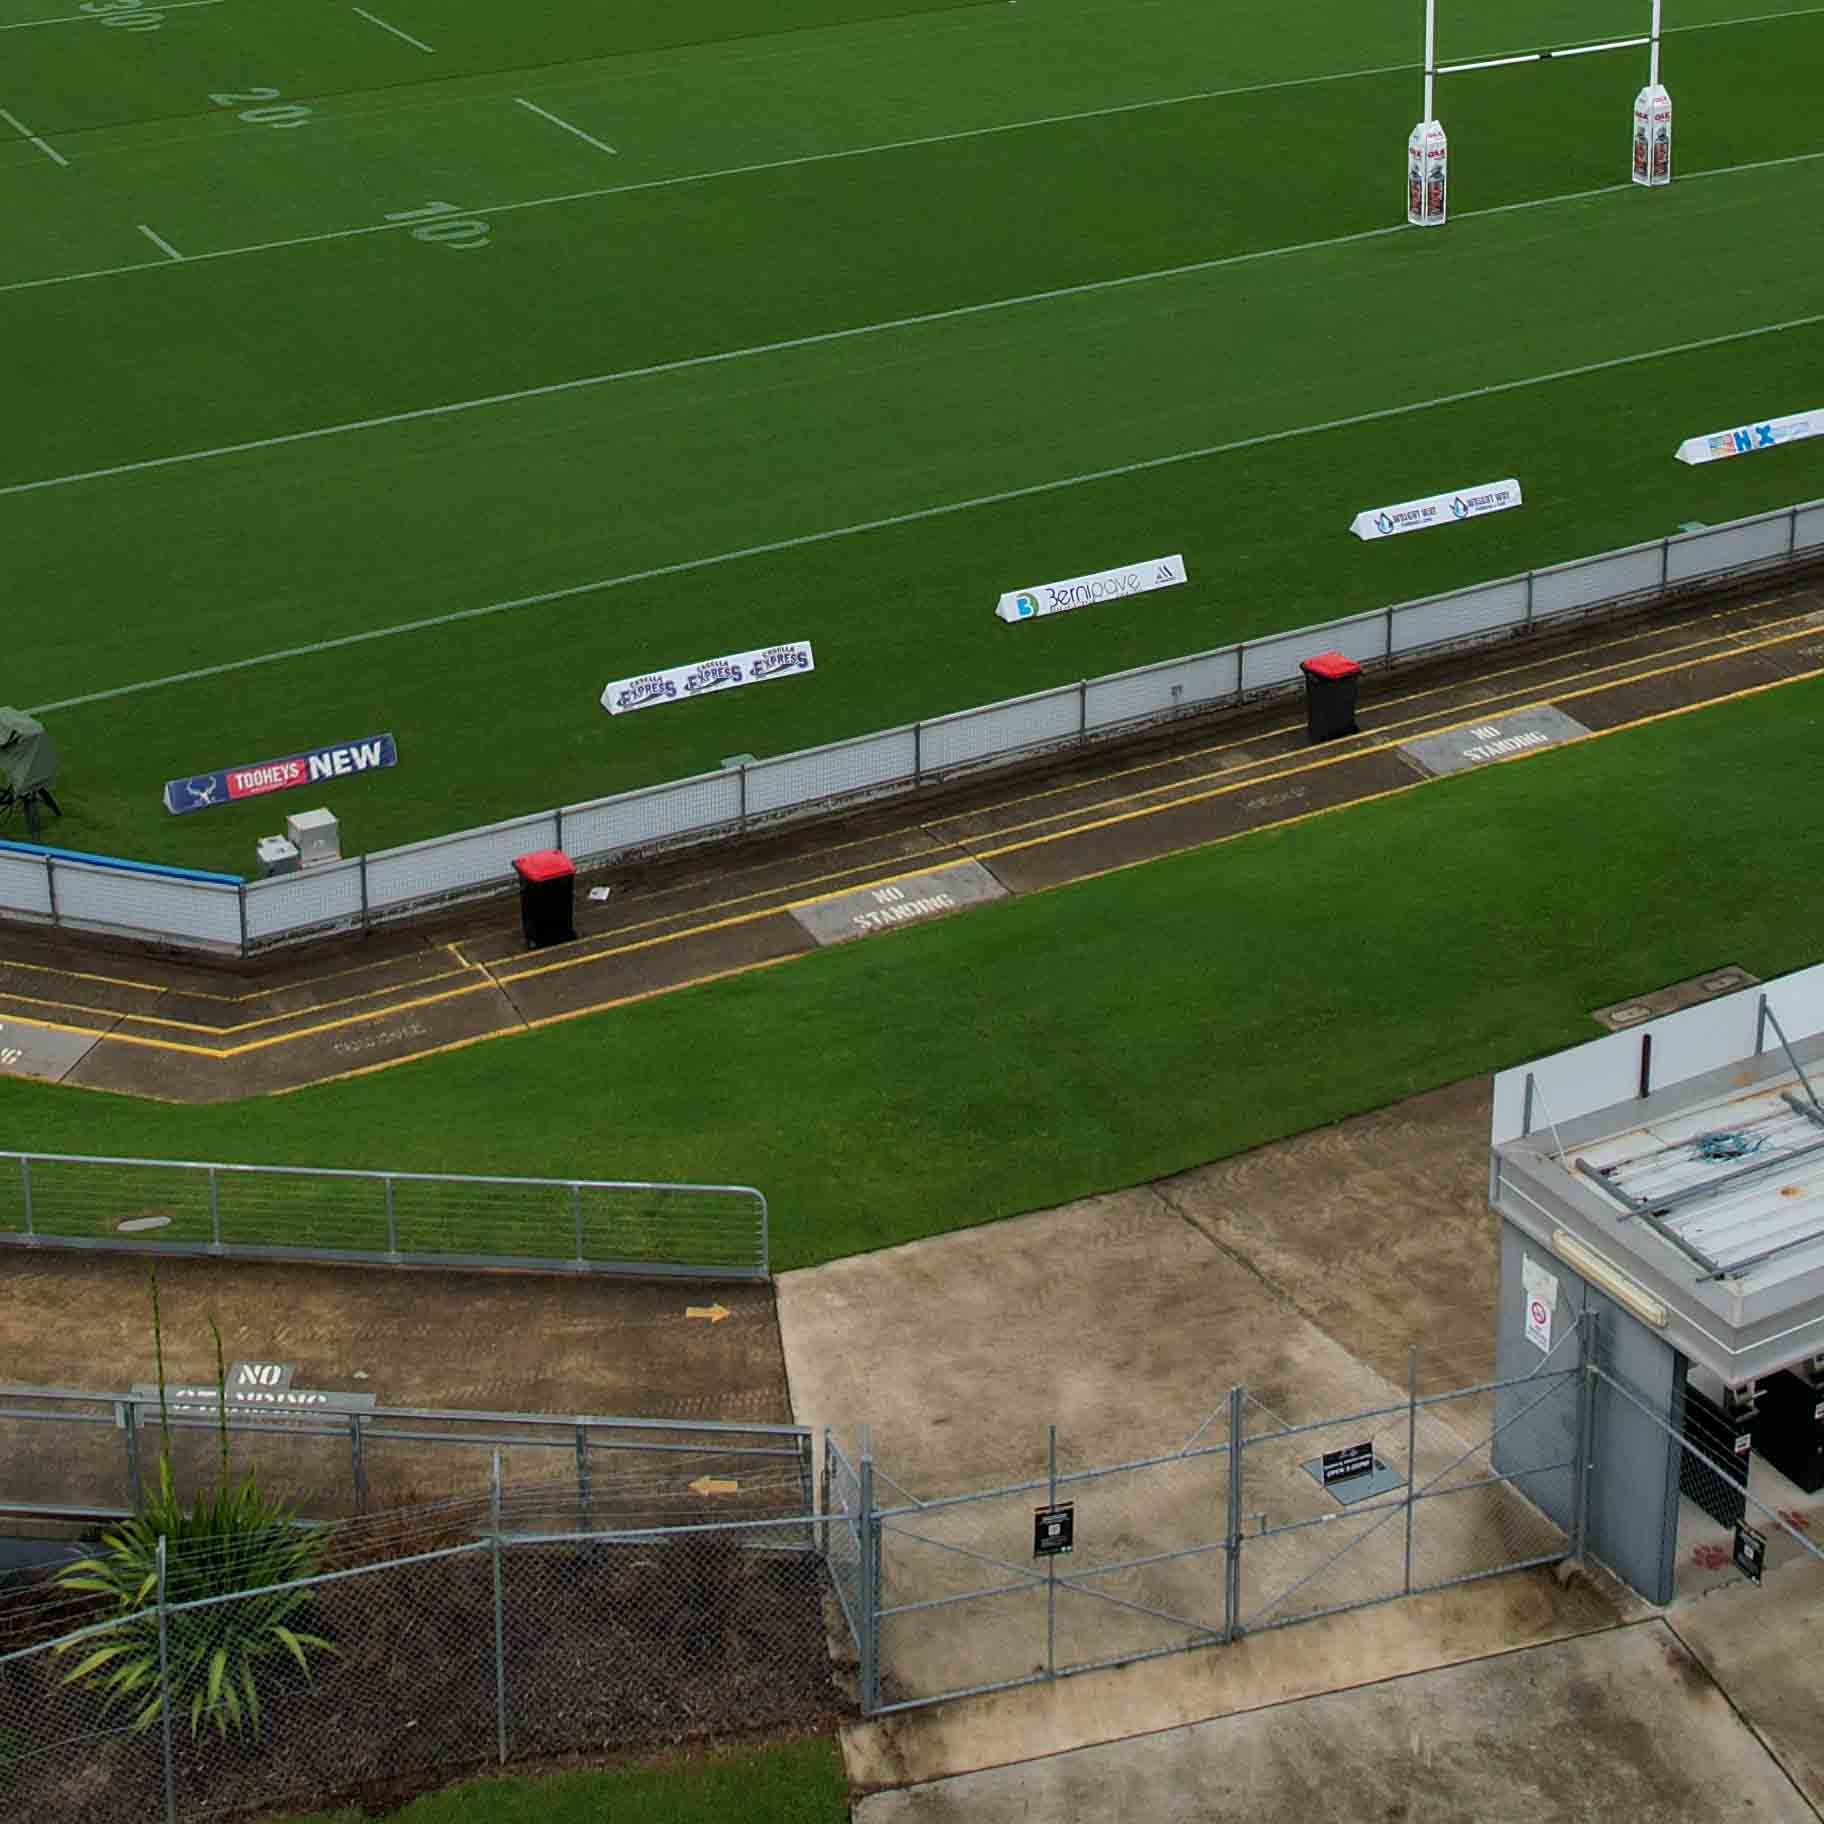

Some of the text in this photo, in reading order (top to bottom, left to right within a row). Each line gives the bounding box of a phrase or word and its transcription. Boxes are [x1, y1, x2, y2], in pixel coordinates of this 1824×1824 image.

[208, 87, 314, 129] 20
[383, 200, 489, 248] 10
[752, 651, 809, 676] EXPRESS
[687, 665, 743, 690] EXPRESS
[619, 680, 678, 706] EXPRESS
[1463, 730, 1549, 762] STANDING
[1471, 726, 1501, 741] NO
[236, 740, 383, 791] TOOHEYS NEW
[871, 886, 905, 905] NO
[852, 892, 955, 930] STANDING
[238, 1364, 282, 1385] NO
